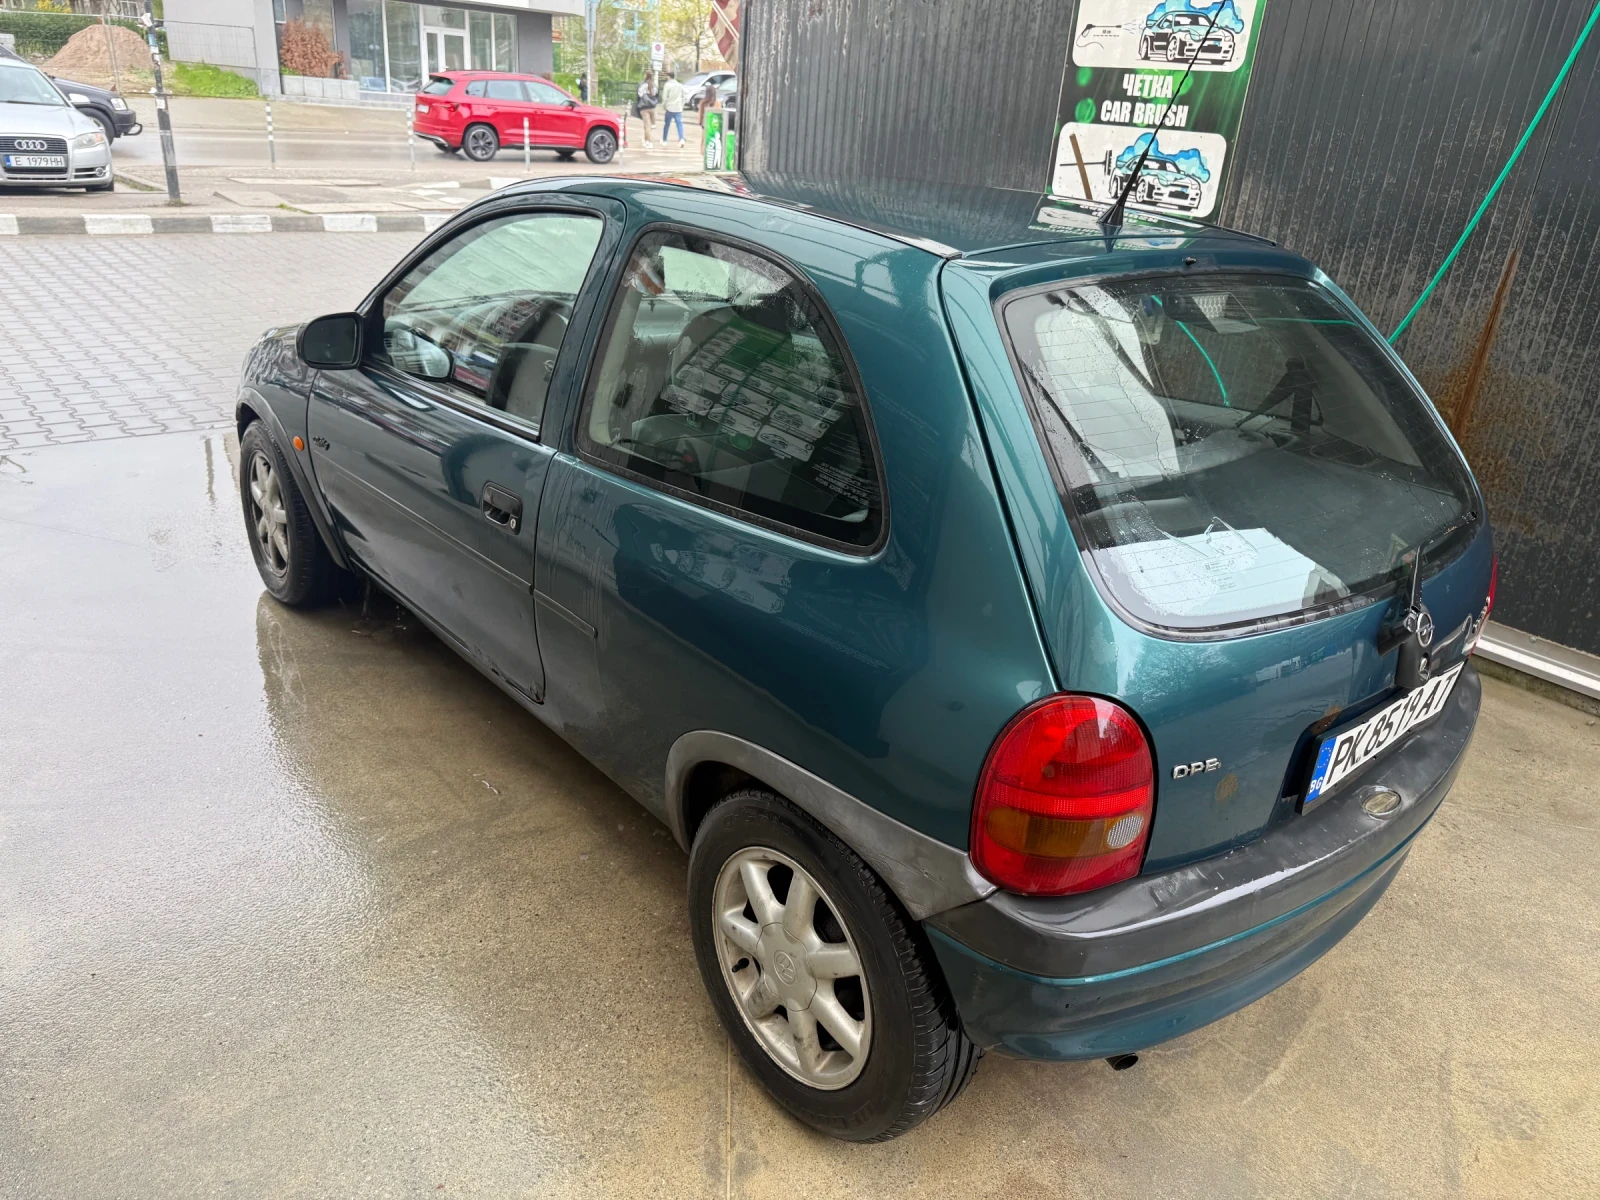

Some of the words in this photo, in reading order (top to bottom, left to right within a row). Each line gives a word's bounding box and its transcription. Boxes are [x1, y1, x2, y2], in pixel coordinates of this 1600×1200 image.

[1122, 74, 1174, 98] ЧЕТКА
[1100, 100, 1132, 123] CAR
[1132, 102, 1189, 127] BRUSH
[14, 157, 22, 166] E
[27, 157, 49, 166] 1979
[1309, 776, 1324, 794] BG
[1326, 723, 1371, 785] PK
[1363, 688, 1424, 757] 8519
[1415, 670, 1459, 720] AT
